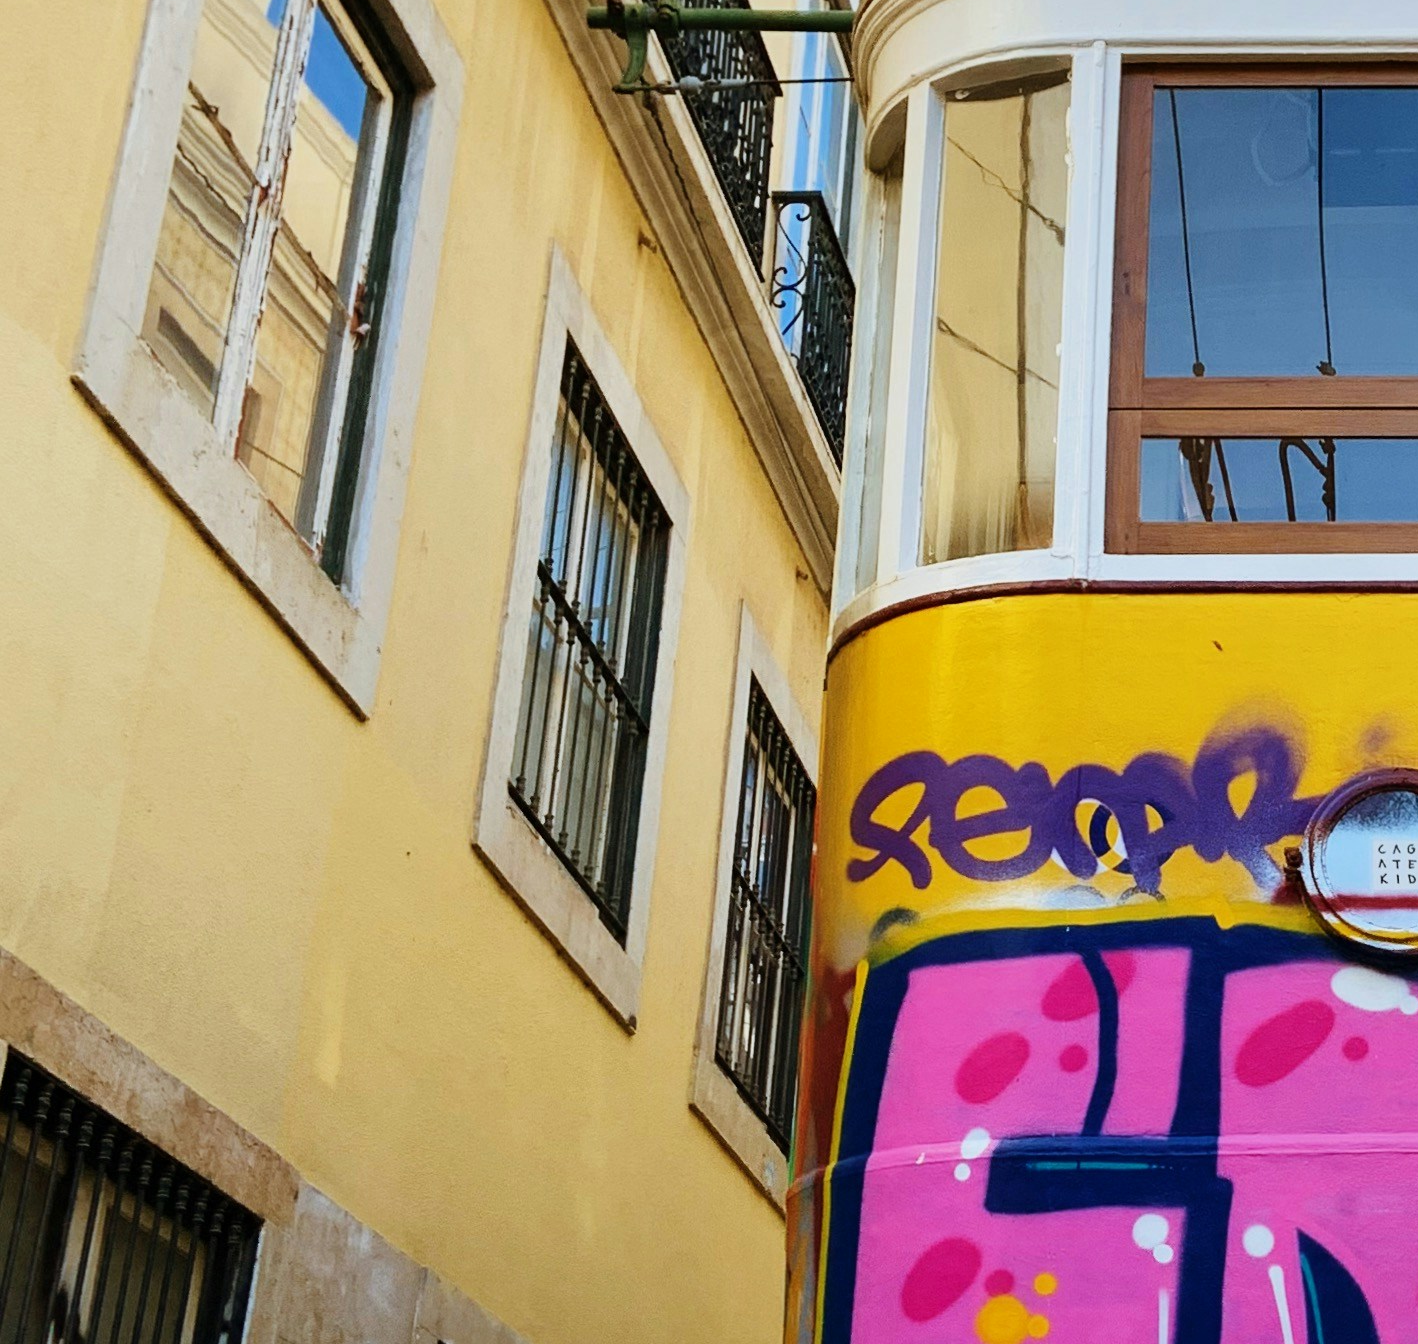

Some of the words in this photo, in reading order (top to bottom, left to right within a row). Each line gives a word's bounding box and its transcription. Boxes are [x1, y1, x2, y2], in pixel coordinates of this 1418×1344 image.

[1378, 843, 1416, 855] CAG
[1378, 858, 1417, 869] ATE
[1380, 873, 1417, 884] KID
